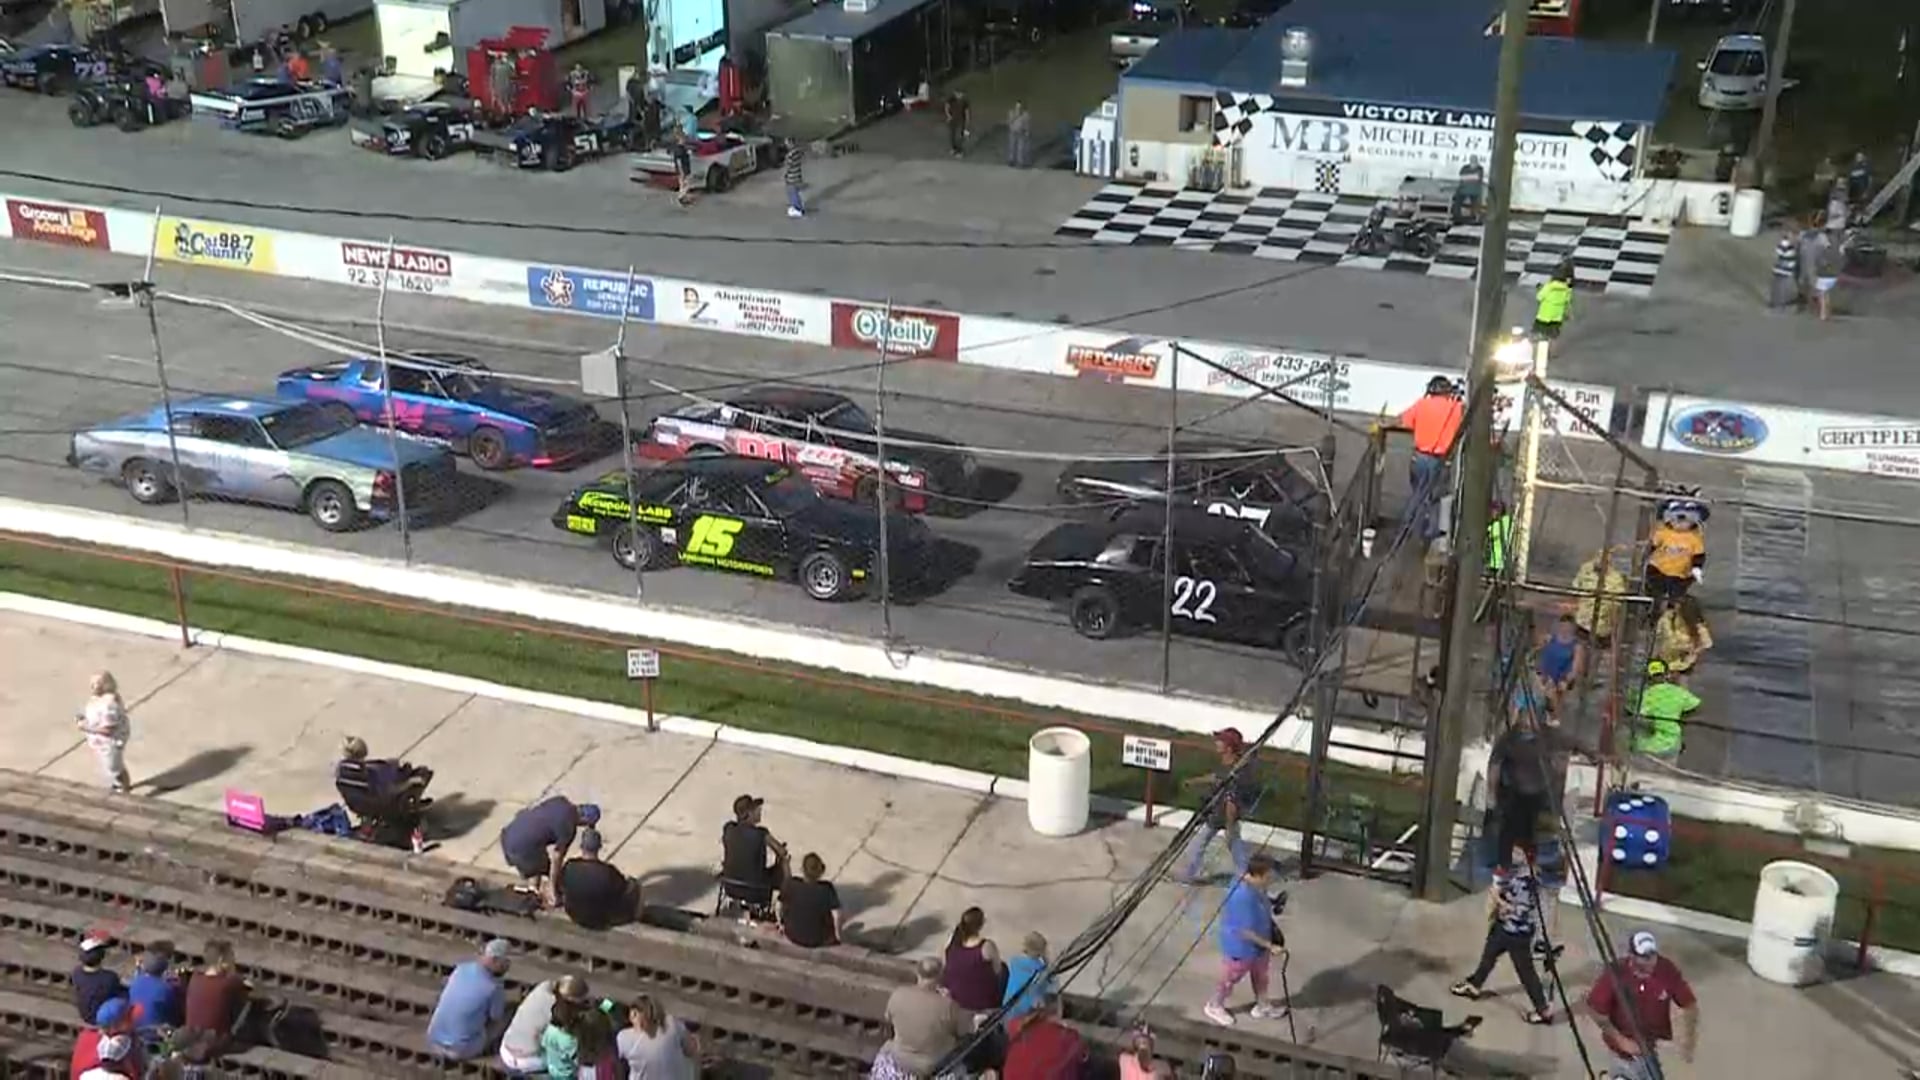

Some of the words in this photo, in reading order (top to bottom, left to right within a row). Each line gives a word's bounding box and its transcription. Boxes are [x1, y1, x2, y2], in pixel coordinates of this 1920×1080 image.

[1343, 103, 1439, 123] VICTORY
[448, 122, 475, 144] 51
[573, 133, 598, 153] 51
[1359, 125, 1459, 149] MICHLES
[19, 204, 68, 227] Grocery
[33, 220, 97, 243] Advantage
[393, 253, 449, 273] RADIO
[400, 275, 433, 292] 1620
[855, 310, 935, 346] O'Reilly
[1821, 428, 1920, 446] CERTIFIE
[638, 504, 673, 519] LABS
[687, 514, 743, 557] 15
[1171, 576, 1216, 624] 22
